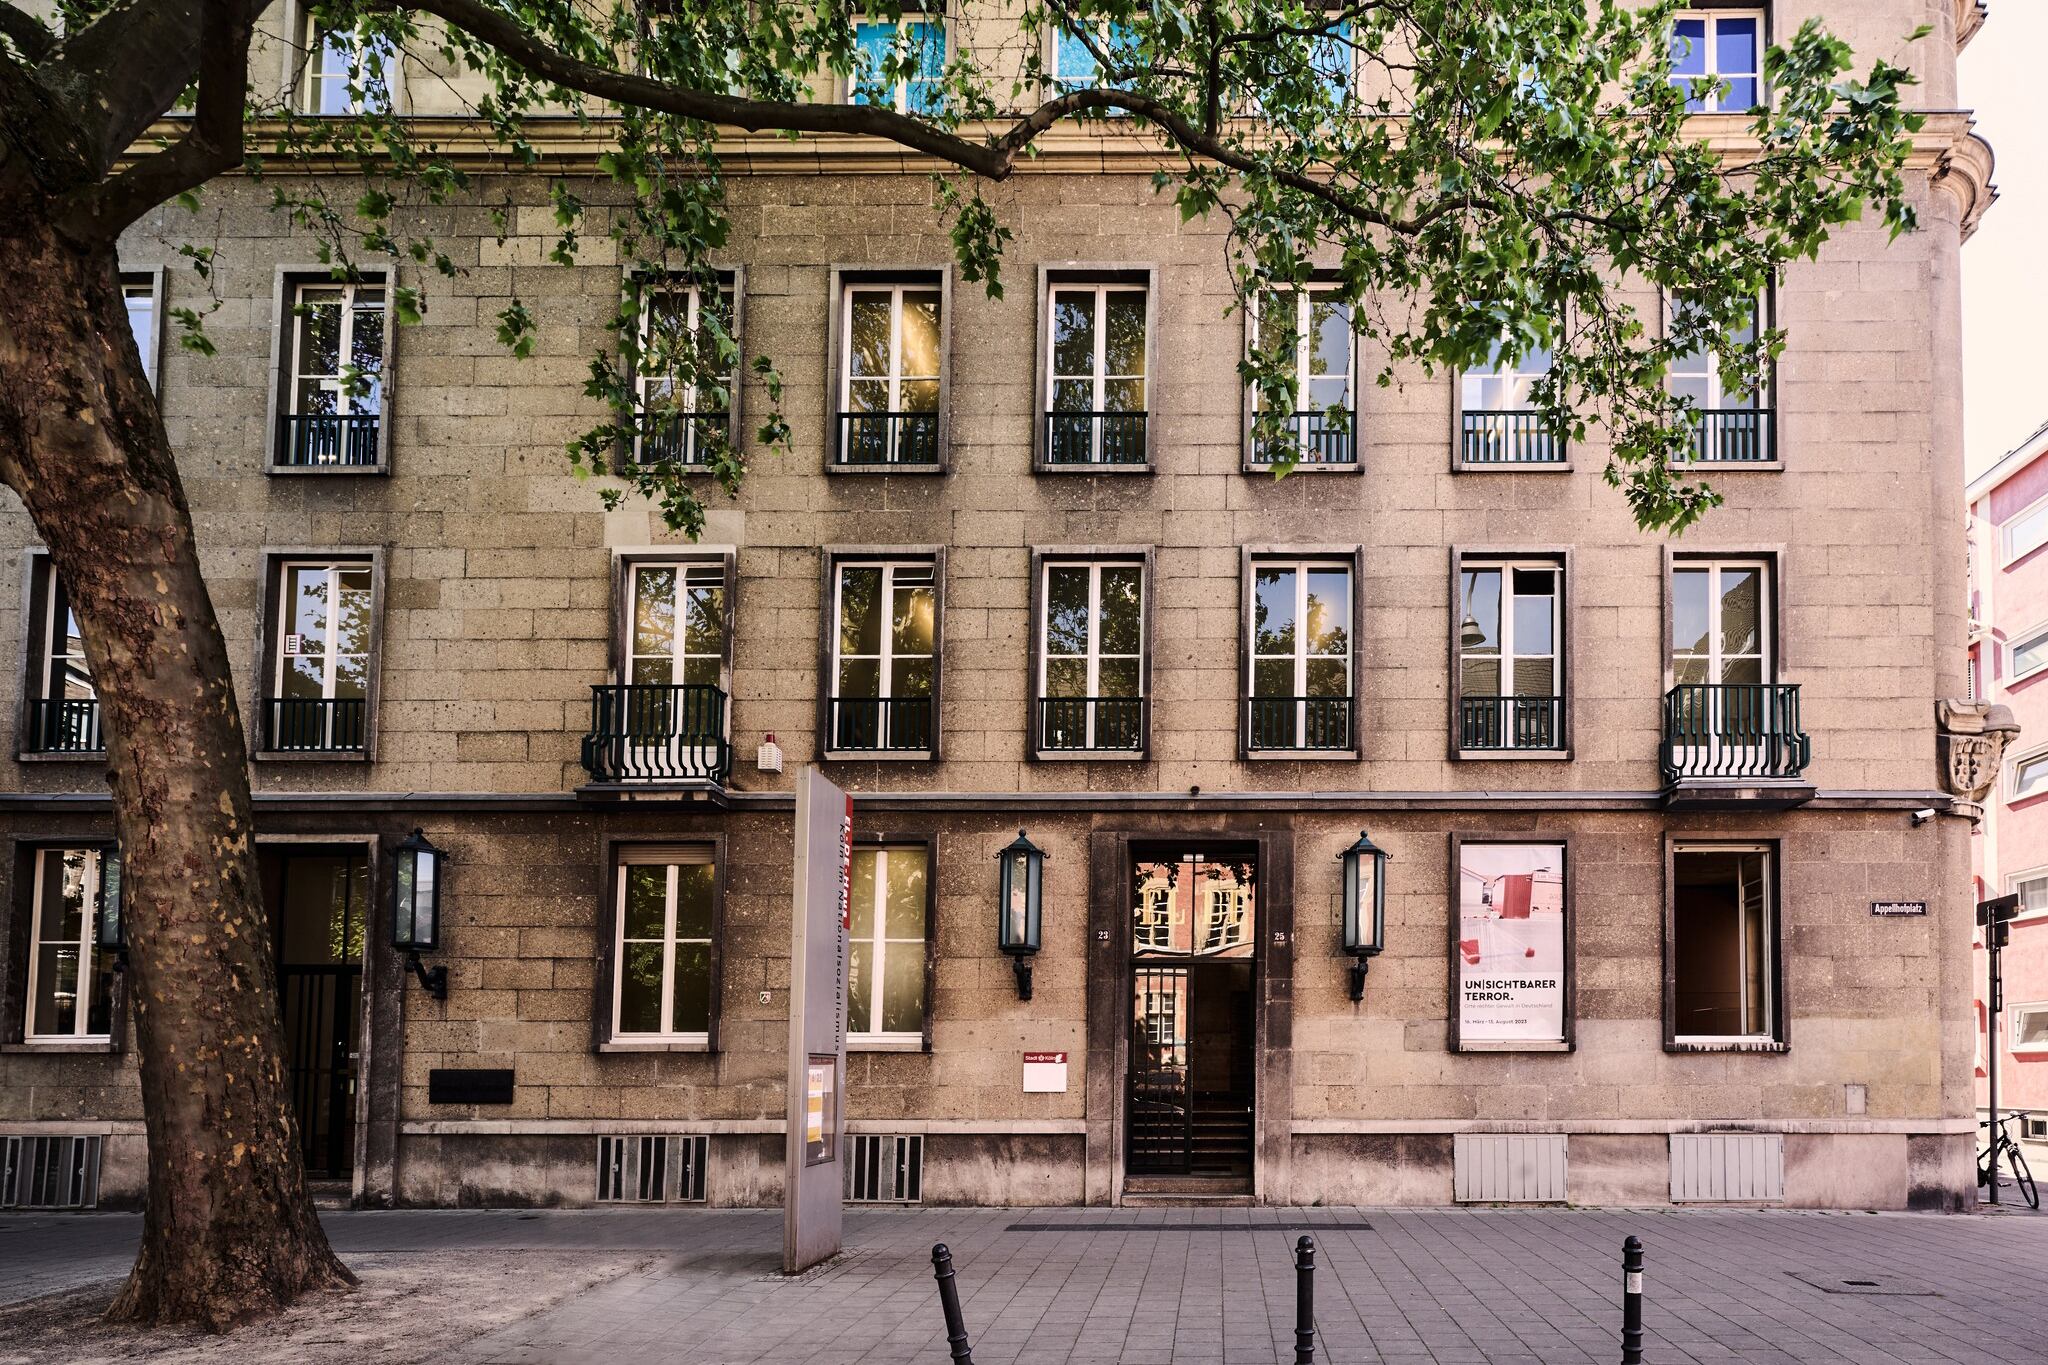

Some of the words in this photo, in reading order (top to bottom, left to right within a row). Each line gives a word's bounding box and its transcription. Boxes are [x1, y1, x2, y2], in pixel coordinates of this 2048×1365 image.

[843, 815, 851, 919] EL-DE-Haus
[838, 865, 845, 883] im
[1874, 903, 1923, 915] Appellhofplatz
[1097, 930, 1109, 941] 23
[1274, 932, 1285, 942] 25
[835, 890, 844, 1051] Nationalsozialismus
[1464, 979, 1556, 990] UN|SICHTBARER
[1464, 992, 1514, 1001] TERROR.
